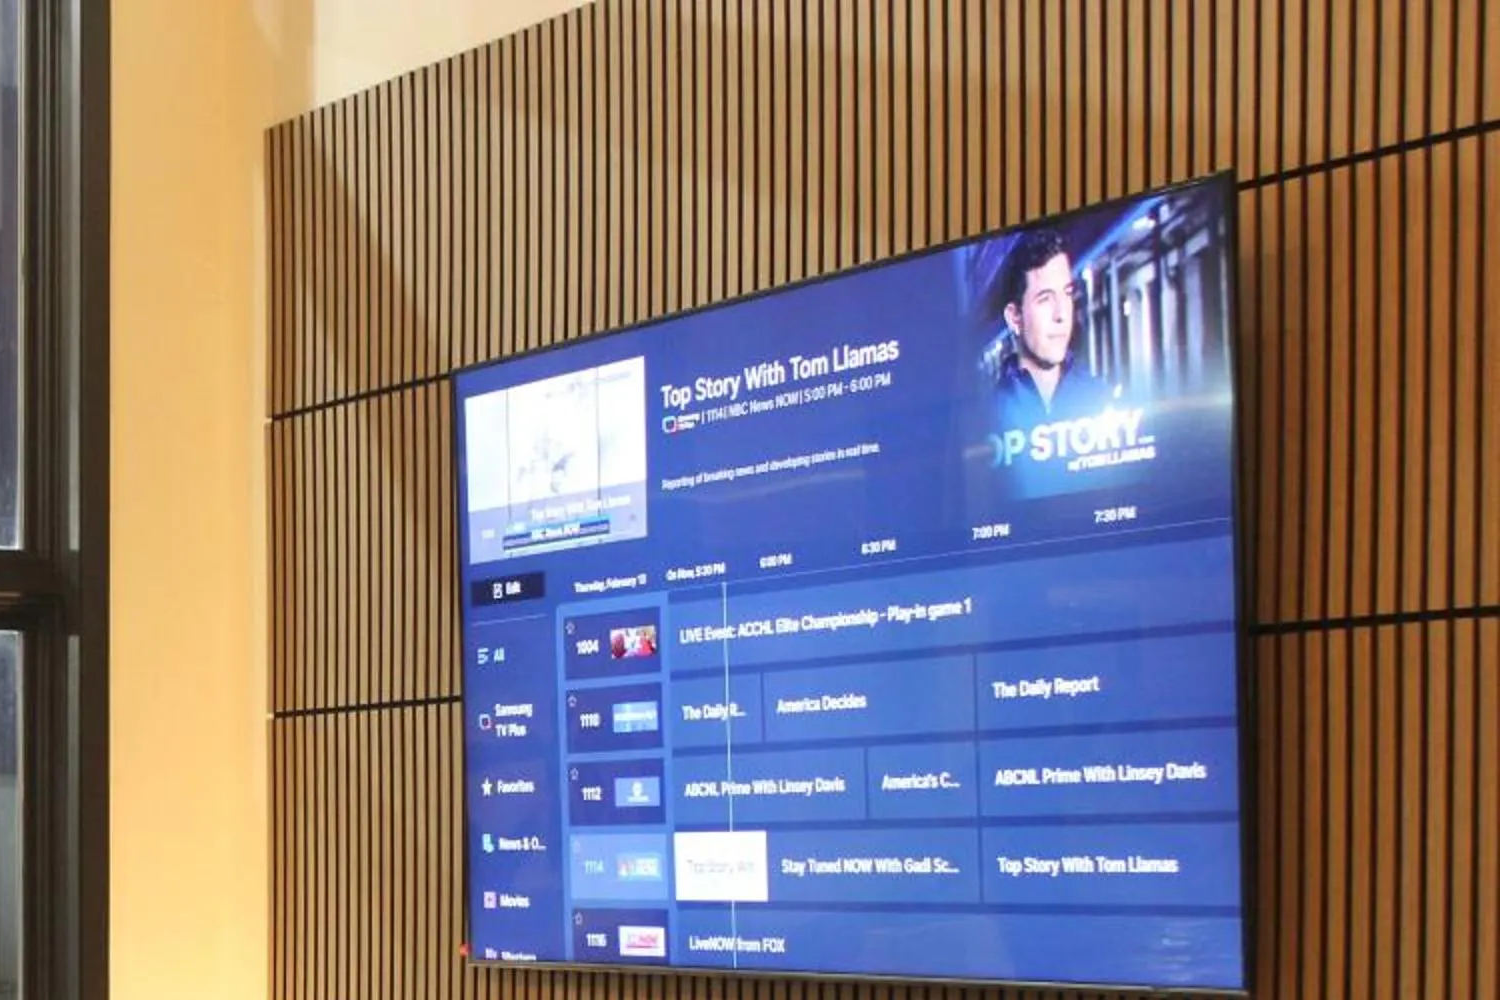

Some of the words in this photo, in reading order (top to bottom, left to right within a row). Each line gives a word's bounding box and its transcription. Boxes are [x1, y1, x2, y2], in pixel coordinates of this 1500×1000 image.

[660, 384, 691, 410] Top
[695, 374, 740, 401] Story
[744, 361, 785, 390] With
[789, 355, 829, 381] Tom
[833, 339, 900, 372] Llamas
[750, 398, 774, 414] News
[776, 393, 799, 409] NOW
[804, 388, 826, 403] 5:00
[827, 384, 842, 397] PM
[850, 377, 873, 392] 6:00
[874, 373, 891, 388] PM
[1030, 406, 1145, 463] STORY
[1094, 508, 1117, 524] 7:30
[1118, 506, 1137, 521] PM
[972, 525, 993, 541] 7:00
[994, 523, 1011, 537] PM
[881, 538, 896, 552] PM
[713, 561, 726, 575] PM
[680, 627, 704, 645] LIVE
[775, 617, 800, 634] Elite
[801, 609, 879, 632] Championship
[927, 602, 962, 622] game
[964, 597, 972, 614] 1
[992, 682, 1017, 699] The
[1019, 679, 1053, 699] Daily
[1054, 676, 1100, 696] Report
[495, 703, 533, 718] Samsung
[682, 705, 701, 720] The
[703, 704, 729, 721] Daily
[776, 697, 820, 714] America
[821, 693, 868, 711] Decides
[495, 724, 507, 737] TV
[508, 723, 527, 737] Plus
[882, 773, 938, 790] America's
[1042, 767, 1081, 784] Prime
[1083, 764, 1116, 783] With
[1118, 764, 1164, 784] Linsey
[1166, 762, 1208, 780] Davis
[497, 779, 535, 795] Favorites
[721, 780, 751, 796] Prime
[751, 779, 778, 794] With
[779, 777, 813, 797] Linsey
[815, 776, 845, 793] Davis
[499, 837, 522, 851] News
[781, 859, 806, 877] Stay
[807, 858, 842, 873] Tuned
[843, 859, 873, 873] NOW
[875, 858, 902, 873] With
[997, 857, 1023, 876] Top
[1024, 858, 1060, 876] Story
[1061, 856, 1094, 873] With
[1095, 856, 1126, 873] Tom
[1128, 857, 1179, 873] Llamas
[500, 894, 530, 908] Movies
[689, 935, 735, 951] LiveNOW
[735, 937, 760, 952] from
[762, 938, 785, 952] FOX
